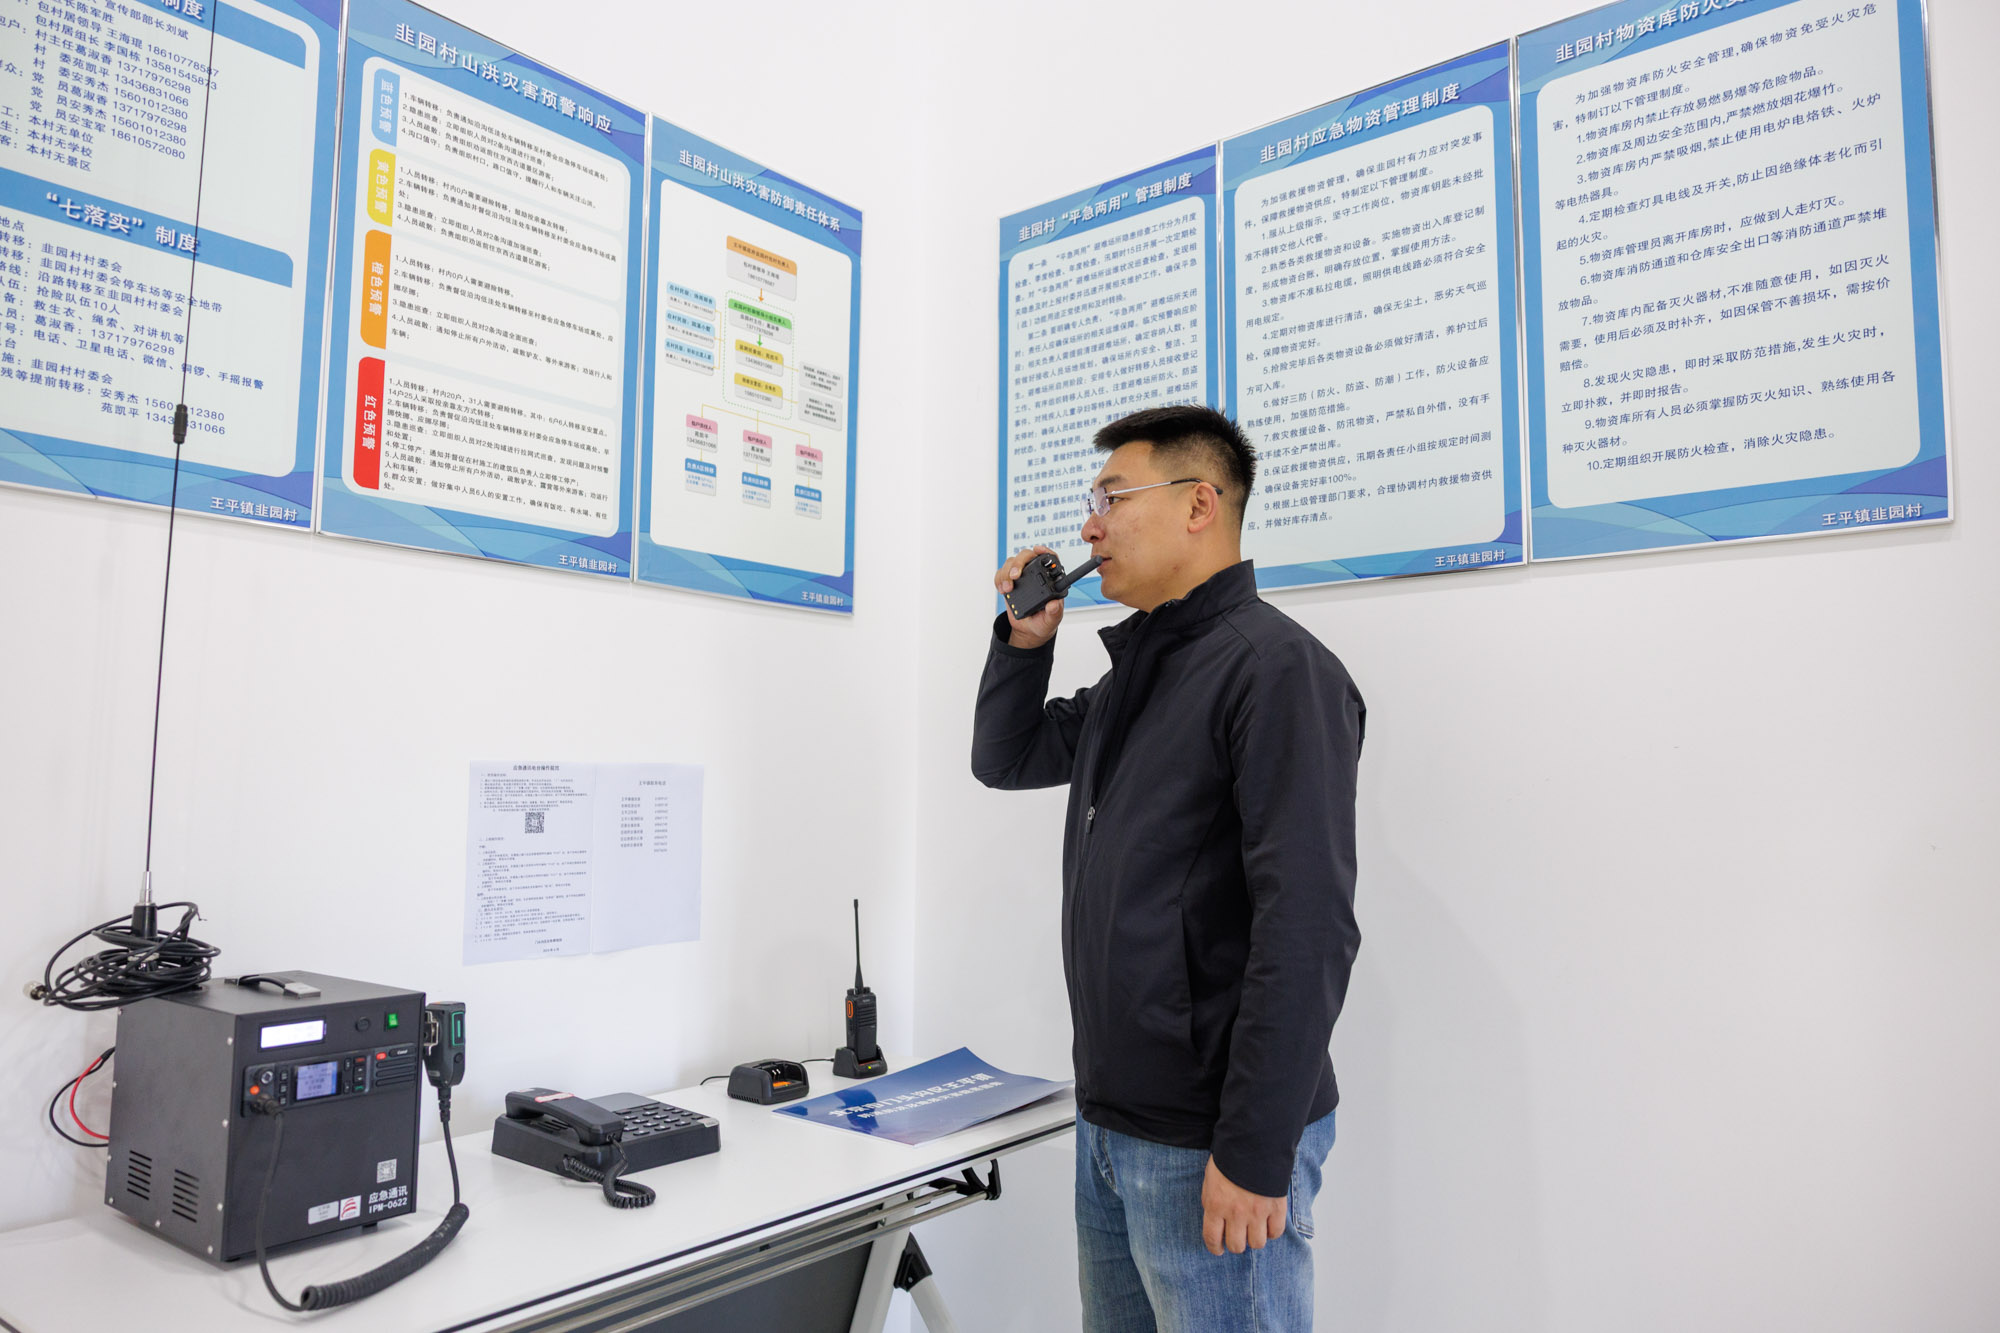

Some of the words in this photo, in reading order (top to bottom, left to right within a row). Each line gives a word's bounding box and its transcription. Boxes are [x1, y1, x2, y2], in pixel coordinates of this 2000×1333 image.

[114, 73, 189, 107] 13436831066
[117, 60, 191, 94] 13717976298
[394, 23, 611, 133] 韭园村山洪灾害预警响应
[112, 100, 187, 134] 13717976298
[114, 87, 188, 120] 15601012380
[1552, 83, 1690, 132] 害，特制订以下管理制度。
[1576, 65, 1824, 144] 1.物资库房内禁止存放易燃易爆等危险物品。
[111, 114, 187, 147] 15601012380
[1259, 82, 1459, 164] 韭园村应急物资管理制度
[111, 128, 186, 160] 18610572080
[678, 149, 840, 232] 韭园村山洪灾害防御责任体系
[1018, 172, 1192, 242] 韭园村“平急两用”管理制度
[1555, 186, 1619, 211] 等电热器具。
[1556, 231, 1608, 252] 起的火灾。
[1579, 195, 1845, 266] 5.物资库管理员离开库房时，应做到人走灯灭。
[1579, 207, 1888, 286] 6.物资库消防通道和仓库安全出口等消防通道严禁堆
[1558, 294, 1598, 312] 放物品。
[1559, 276, 1891, 352] 需要，使用后必须及时补齐，如因保管不善损坏，需按价
[1559, 358, 1589, 373] 赔偿。
[1561, 382, 1689, 413] 立即扑救，并即时报告。
[1584, 370, 1896, 430] 9.物资库所有人员必须掌握防灭火知识、熟练使用各
[1562, 435, 1628, 454] 种灭火器材。
[1586, 427, 1835, 471] 10.定期组织开展防火检查，消除火灾隐患。
[209, 496, 297, 522] 王平镇韭园村
[1821, 503, 1922, 526] 王平镇韭园村
[558, 554, 617, 573] 王平镇韭园村
[1434, 548, 1505, 567] 王平镇韭园村
[368, 1185, 408, 1204] 应急通讯
[369, 1197, 408, 1214] IPM-0622
